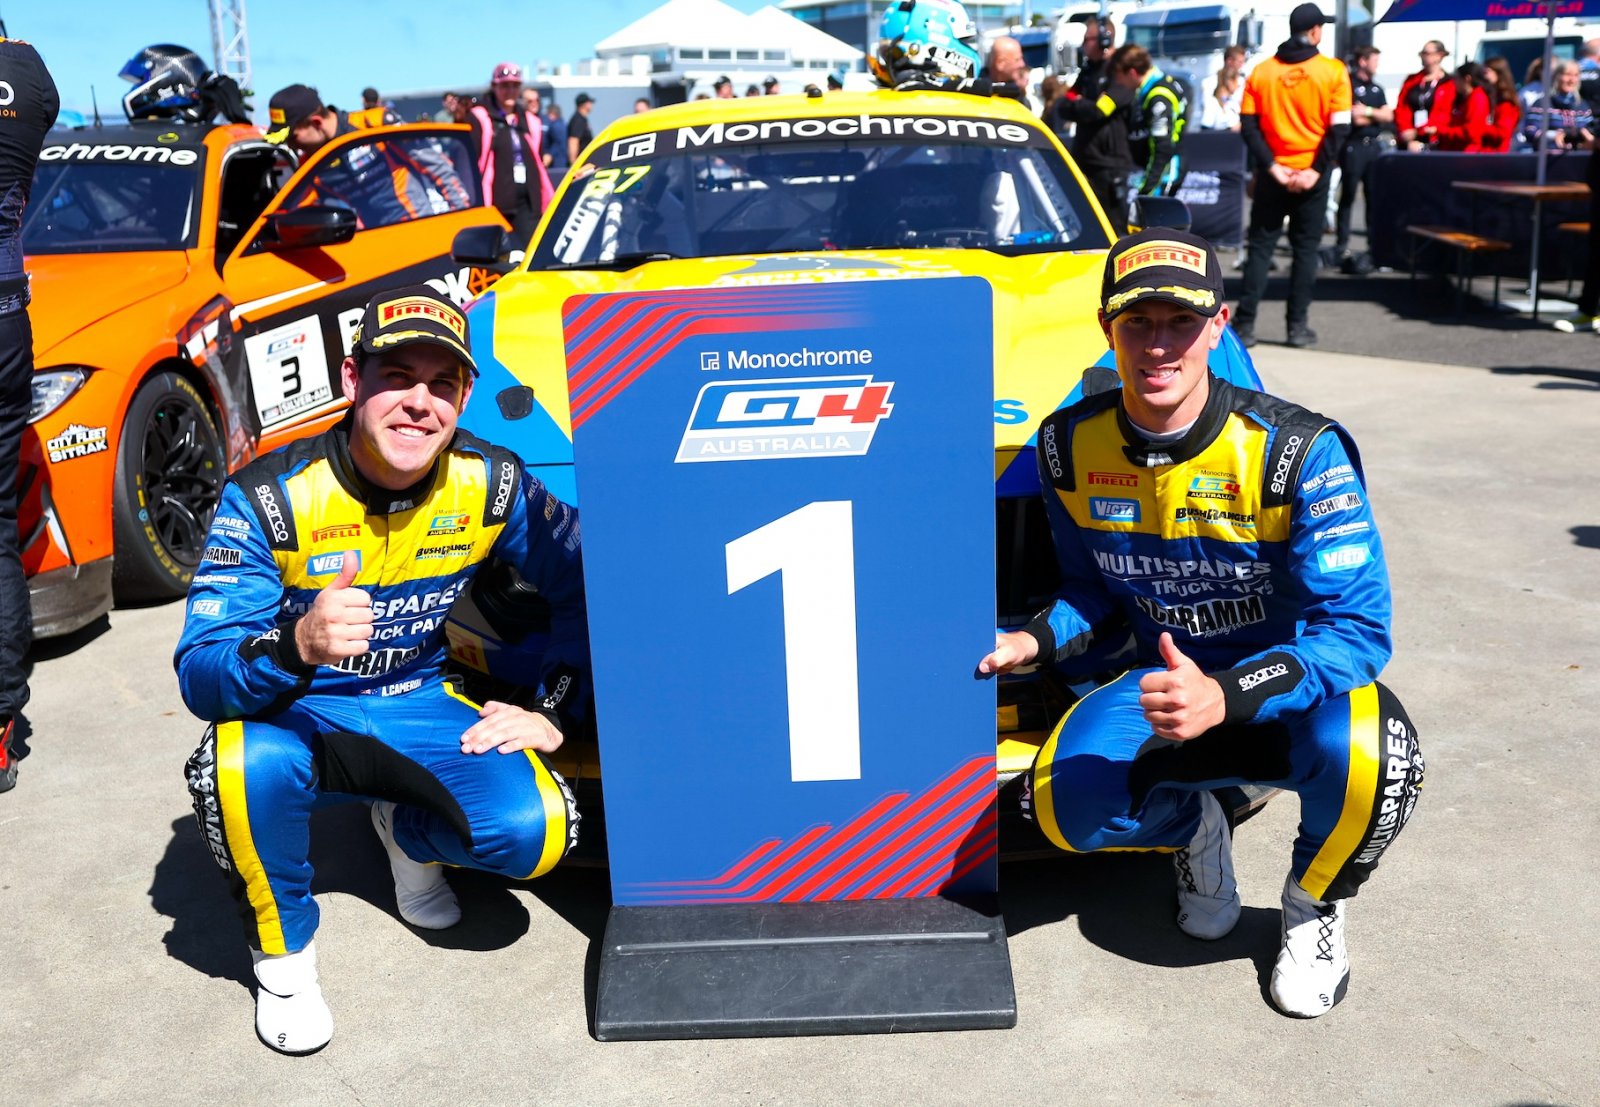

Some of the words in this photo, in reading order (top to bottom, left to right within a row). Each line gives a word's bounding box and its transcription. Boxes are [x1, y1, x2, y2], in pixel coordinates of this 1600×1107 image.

[676, 113, 1029, 148] Monochrome
[1118, 246, 1201, 276] PIRELLI
[383, 303, 462, 334] PIRELLI
[728, 348, 872, 370] Monochrome
[281, 356, 301, 398] 3
[694, 380, 890, 430] GT4
[50, 440, 108, 462] SITRAK
[700, 436, 852, 454] AUSTRALIA
[1043, 424, 1063, 478] sparco
[1088, 472, 1138, 487] PIRELLI
[1270, 435, 1304, 495] sparco
[492, 461, 515, 517] sparco
[254, 484, 289, 543] sparco
[1094, 500, 1135, 517] VICTA
[313, 555, 345, 572] VICT
[1093, 549, 1271, 580] MULTISPARES
[1152, 580, 1215, 597] TRUCK
[725, 500, 861, 782] 1
[1239, 663, 1289, 691] sparco
[1355, 718, 1411, 864] MULTISPARES
